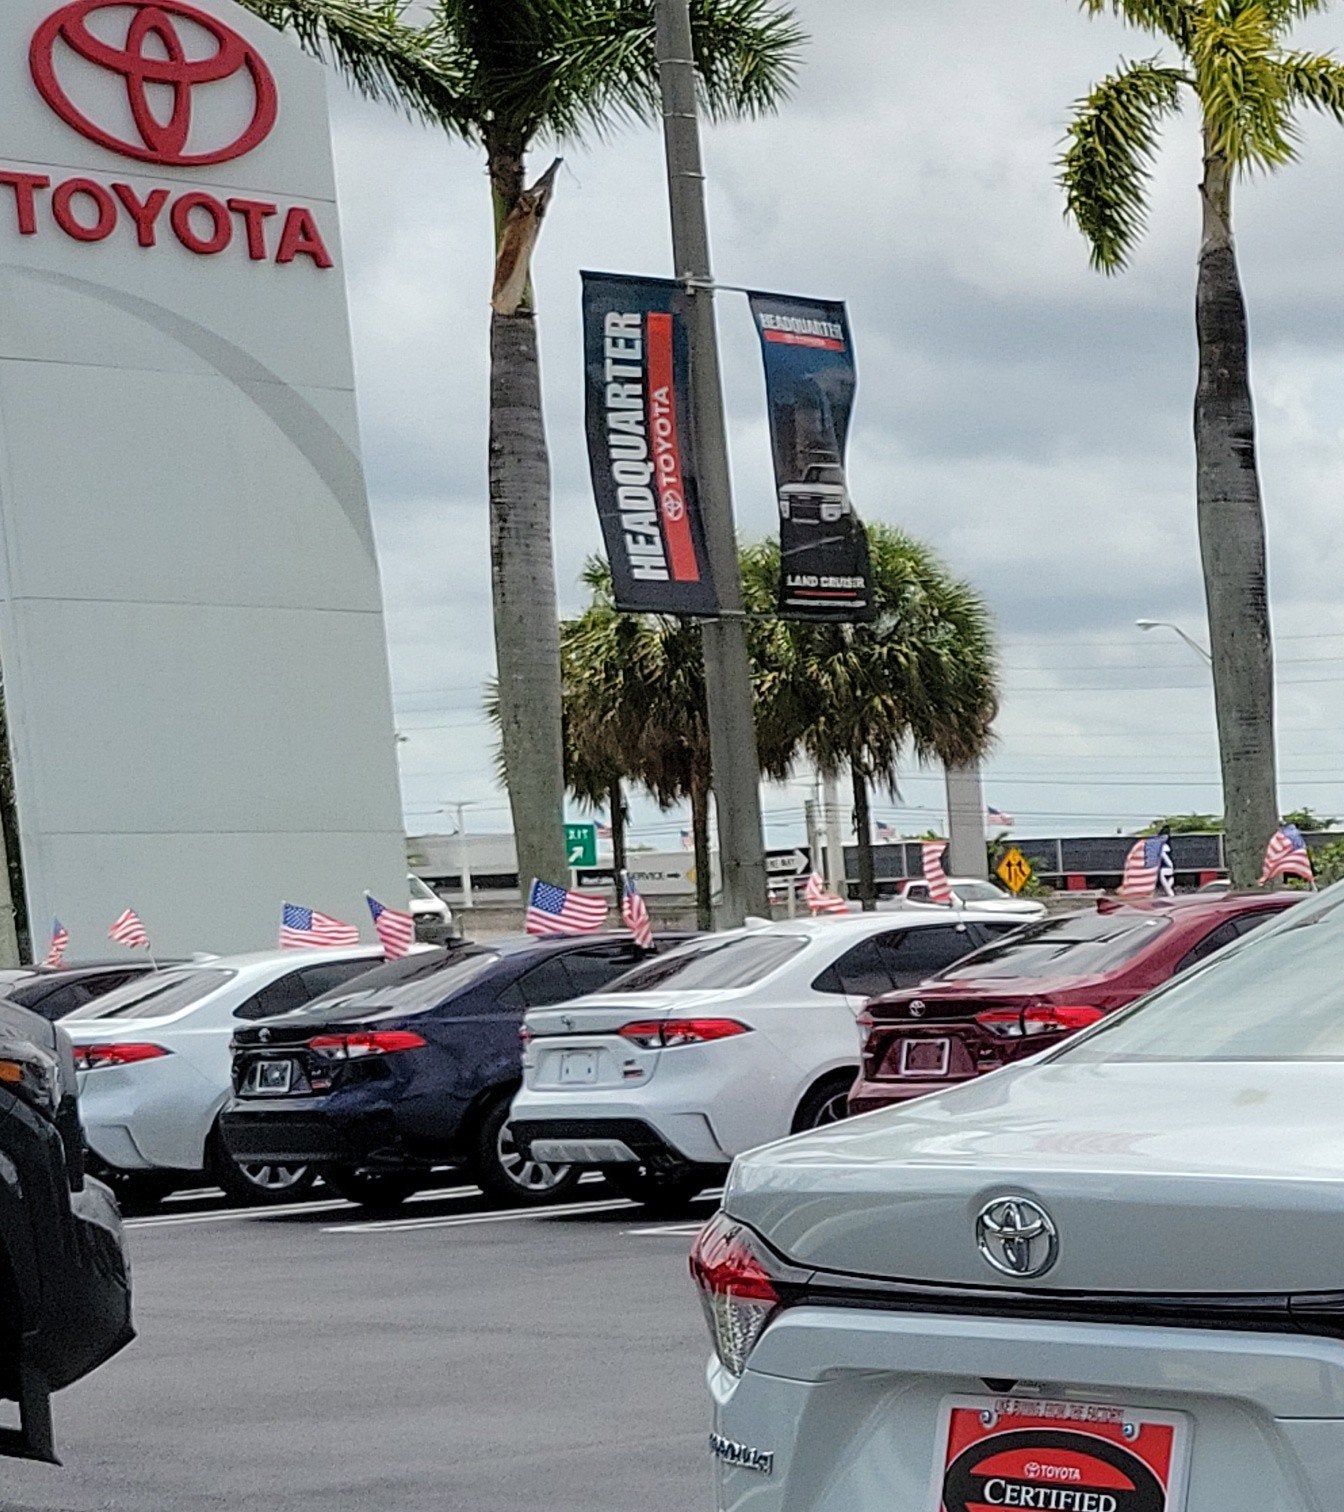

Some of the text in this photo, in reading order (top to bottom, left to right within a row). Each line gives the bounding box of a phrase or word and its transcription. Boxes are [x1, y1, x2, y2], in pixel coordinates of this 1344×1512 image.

[0, 170, 334, 269] TOYOTA
[604, 311, 670, 581] HEADQUARTER
[651, 386, 677, 488] TOYOTA
[786, 574, 819, 587] LAND
[568, 828, 589, 840] XIT
[1040, 1464, 1081, 1481] TOYOTA
